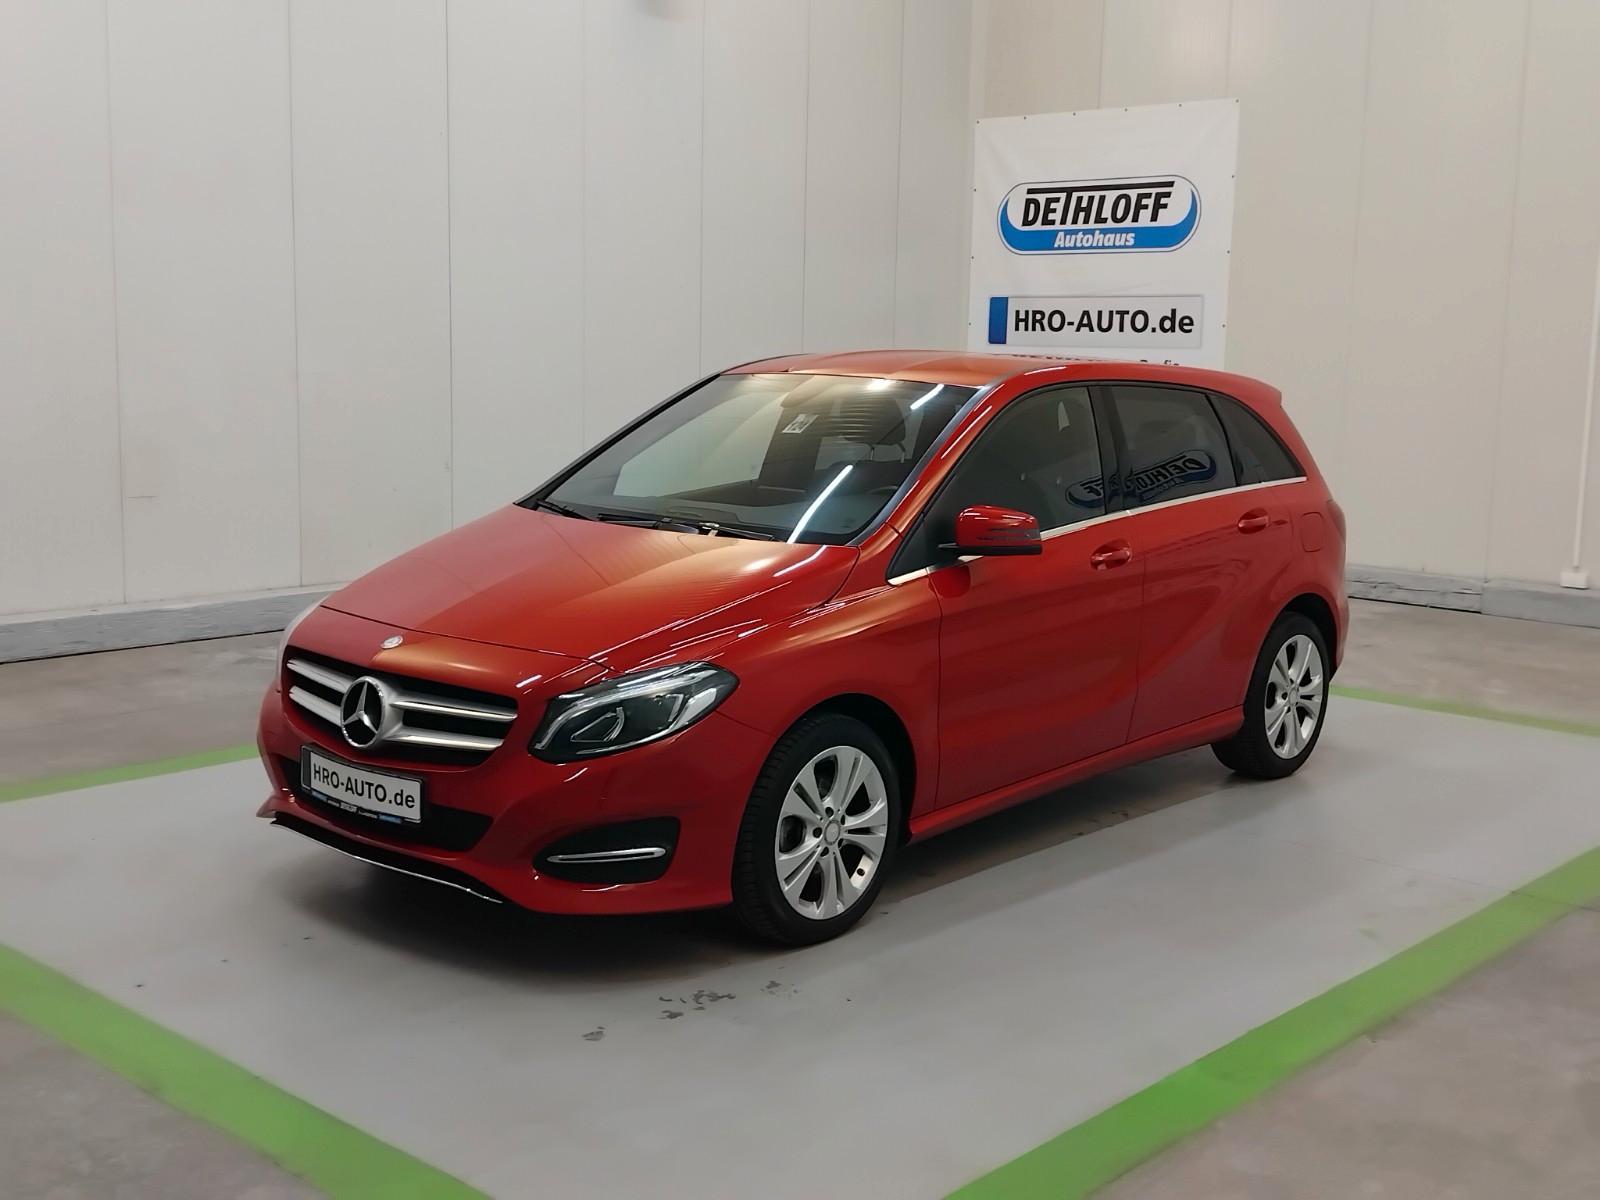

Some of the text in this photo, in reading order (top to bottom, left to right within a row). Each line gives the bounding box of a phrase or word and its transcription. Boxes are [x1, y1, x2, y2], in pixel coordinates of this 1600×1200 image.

[1021, 181, 1175, 227] DETHLOFF
[1053, 230, 1136, 248] Autohaus
[1014, 308, 1195, 334] HRO-AUTO.de
[313, 762, 415, 809] HRO-AUTO.de
